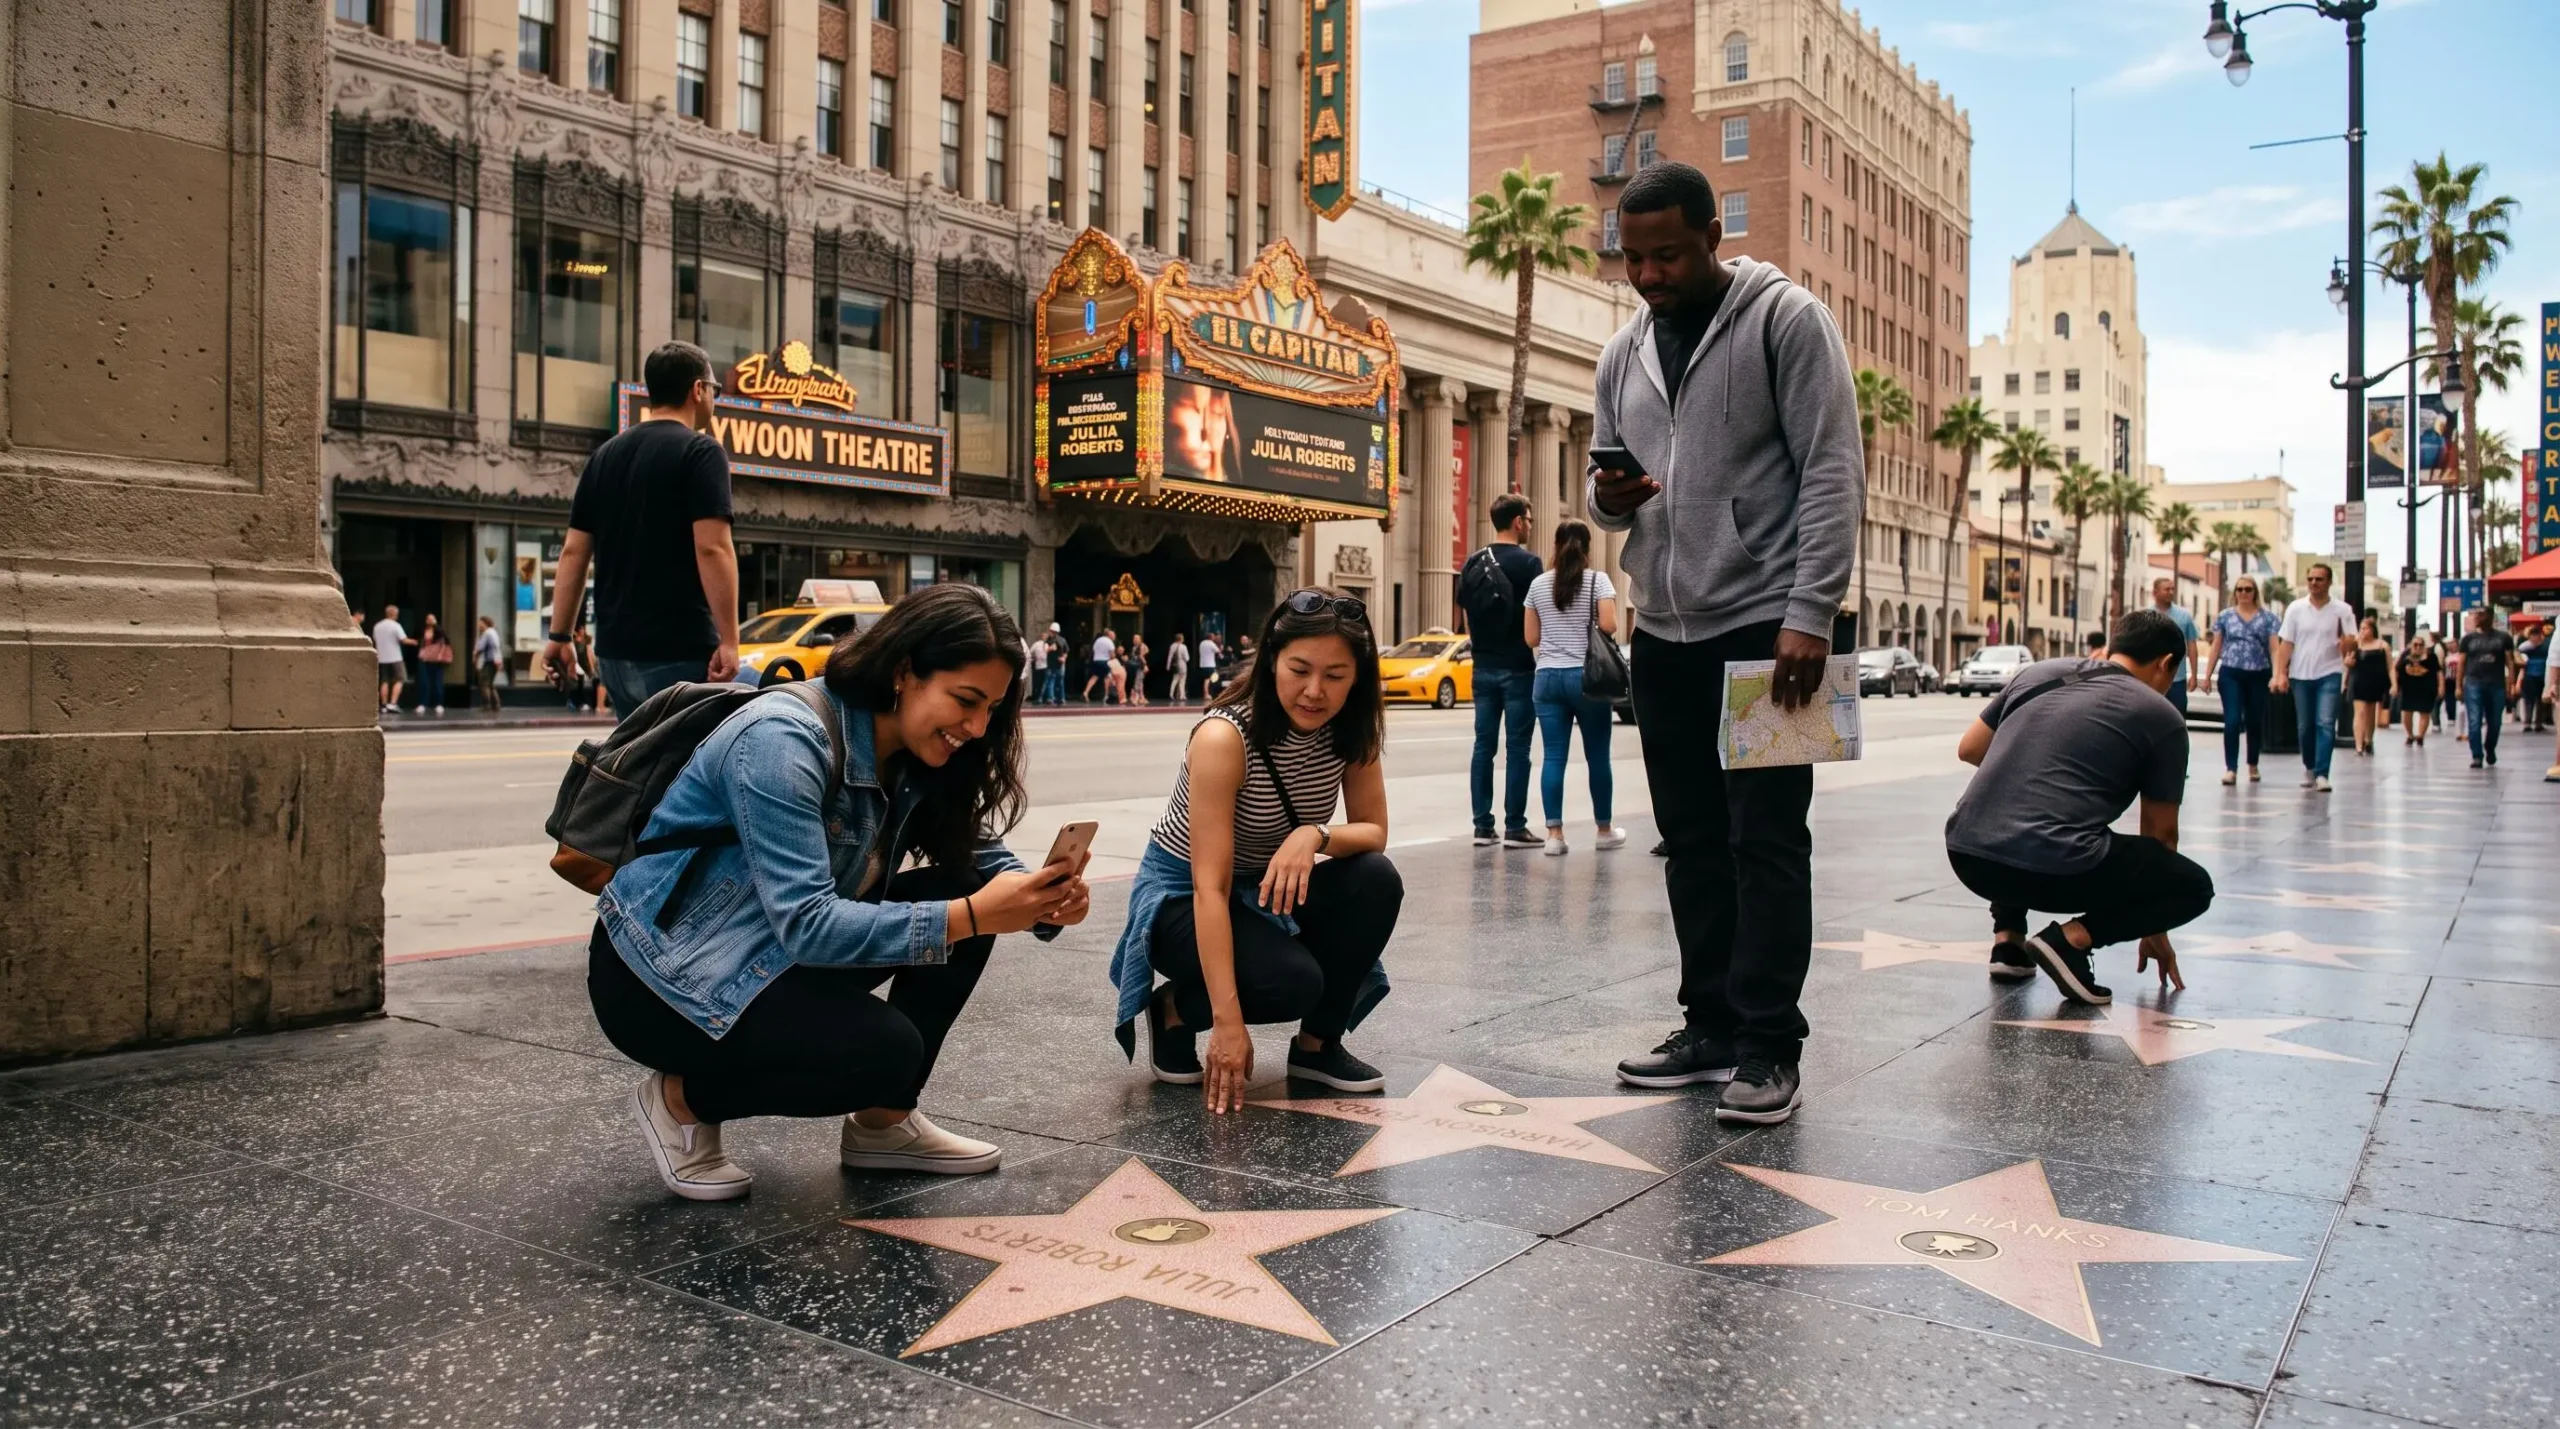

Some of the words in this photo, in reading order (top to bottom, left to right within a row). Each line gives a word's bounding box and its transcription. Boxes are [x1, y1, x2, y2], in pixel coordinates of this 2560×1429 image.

[1311, 0, 1343, 187] ITAN
[1211, 315, 1244, 349] EL
[822, 430, 934, 476] THEATRE
[1060, 439, 1124, 456] ROBERTS
[1251, 438, 1293, 461] JULIA
[1295, 446, 1356, 473] ROBERTS
[1423, 1117, 1593, 1151] HARRISON
[1863, 1194, 1950, 1221] TOM
[1963, 1213, 2111, 1249] HANKS
[961, 1223, 1138, 1272] ROBERTS
[1141, 1263, 1261, 1300] JULIA
